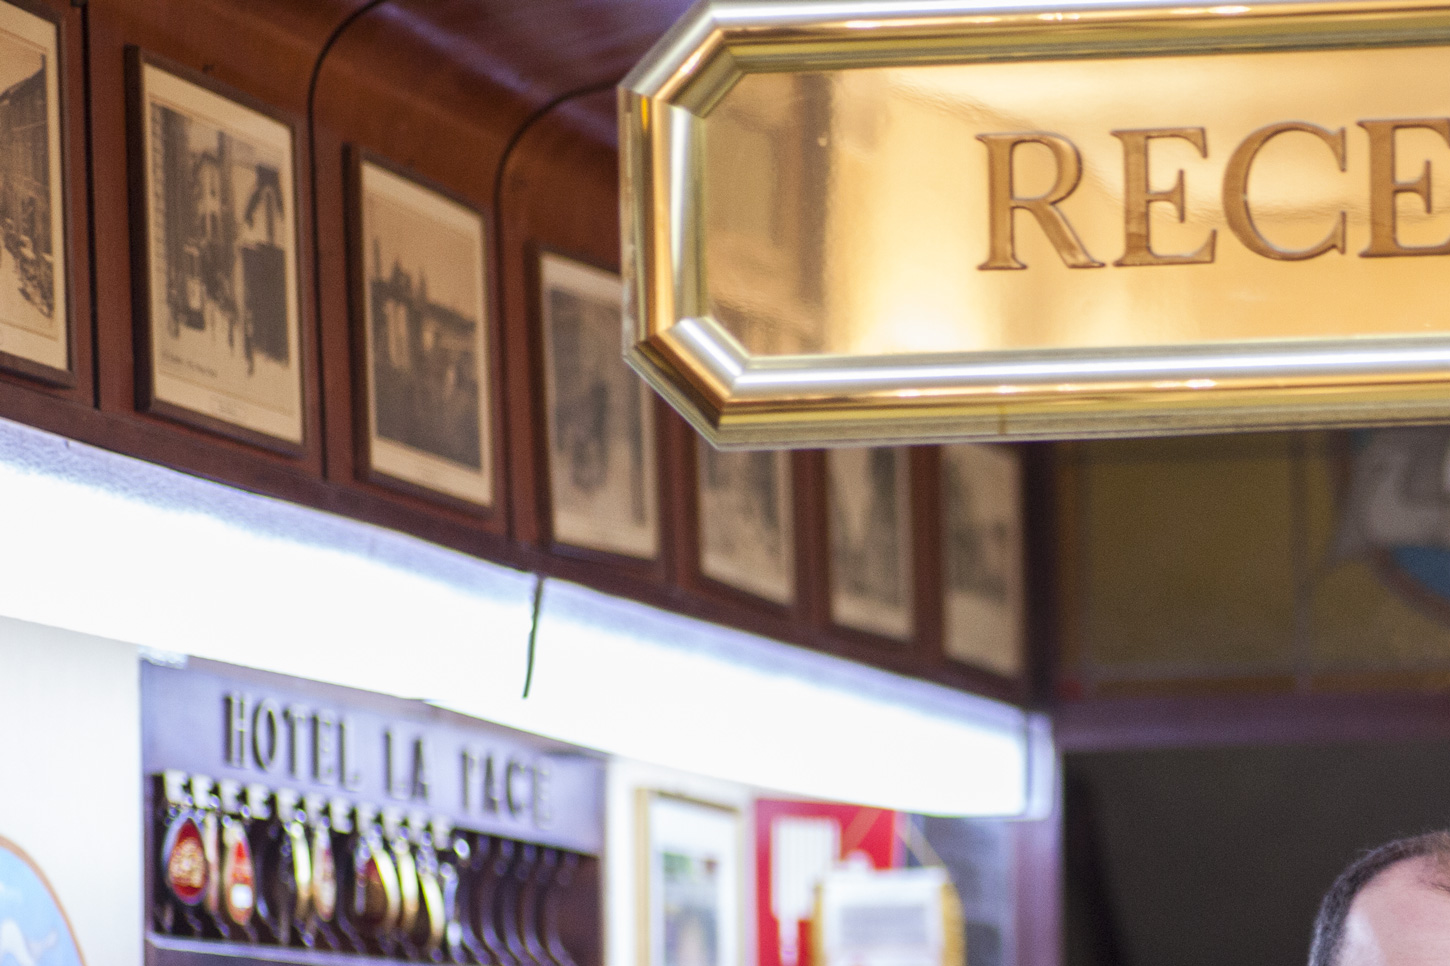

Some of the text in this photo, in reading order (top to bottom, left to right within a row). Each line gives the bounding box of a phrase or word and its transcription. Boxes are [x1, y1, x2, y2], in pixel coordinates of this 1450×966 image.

[222, 690, 556, 832] HOTEL LA PACE
